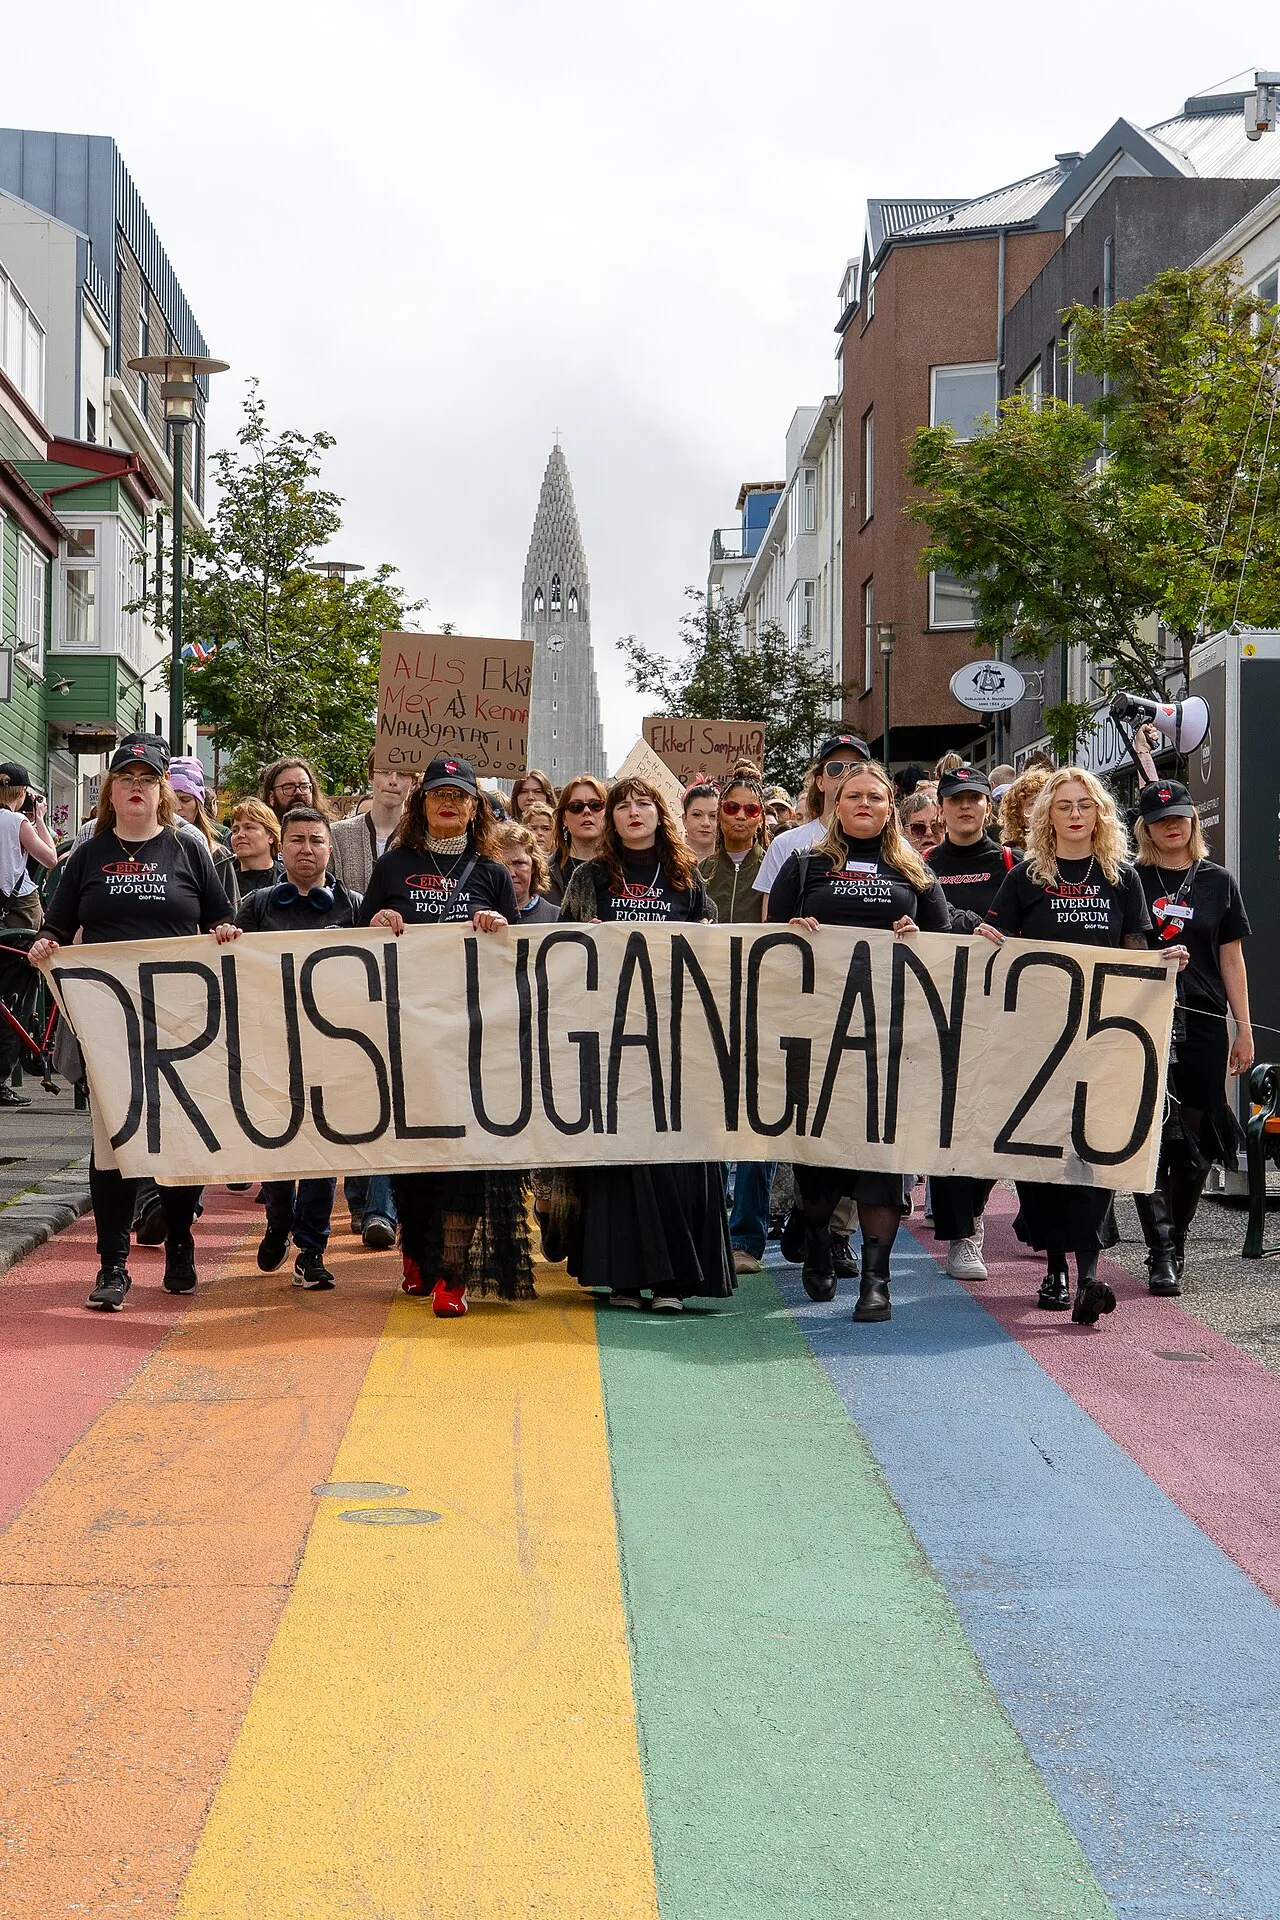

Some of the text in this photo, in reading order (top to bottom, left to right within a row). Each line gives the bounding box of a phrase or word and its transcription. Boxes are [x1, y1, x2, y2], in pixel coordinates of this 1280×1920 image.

[393, 651, 466, 684] ALLS
[384, 684, 438, 716] Mér
[650, 725, 695, 754] Ekkert
[388, 747, 422, 764] eru
[116, 863, 158, 873] EIN AF
[105, 873, 168, 884] HVERJUM
[420, 876, 441, 887] EIN
[829, 879, 893, 887] HVERJUM
[110, 882, 166, 895] FJÓRUM
[622, 886, 664, 898] EIN AF
[833, 884, 892, 896] FJÓRUM
[1059, 885, 1101, 895] EIN AF
[409, 889, 471, 902] HVERJM
[610, 898, 672, 912] HVERJUM
[1050, 898, 1111, 909] HVERJUM
[615, 909, 667, 922] FJÓRUM
[1057, 909, 1109, 923] FJÓRUM
